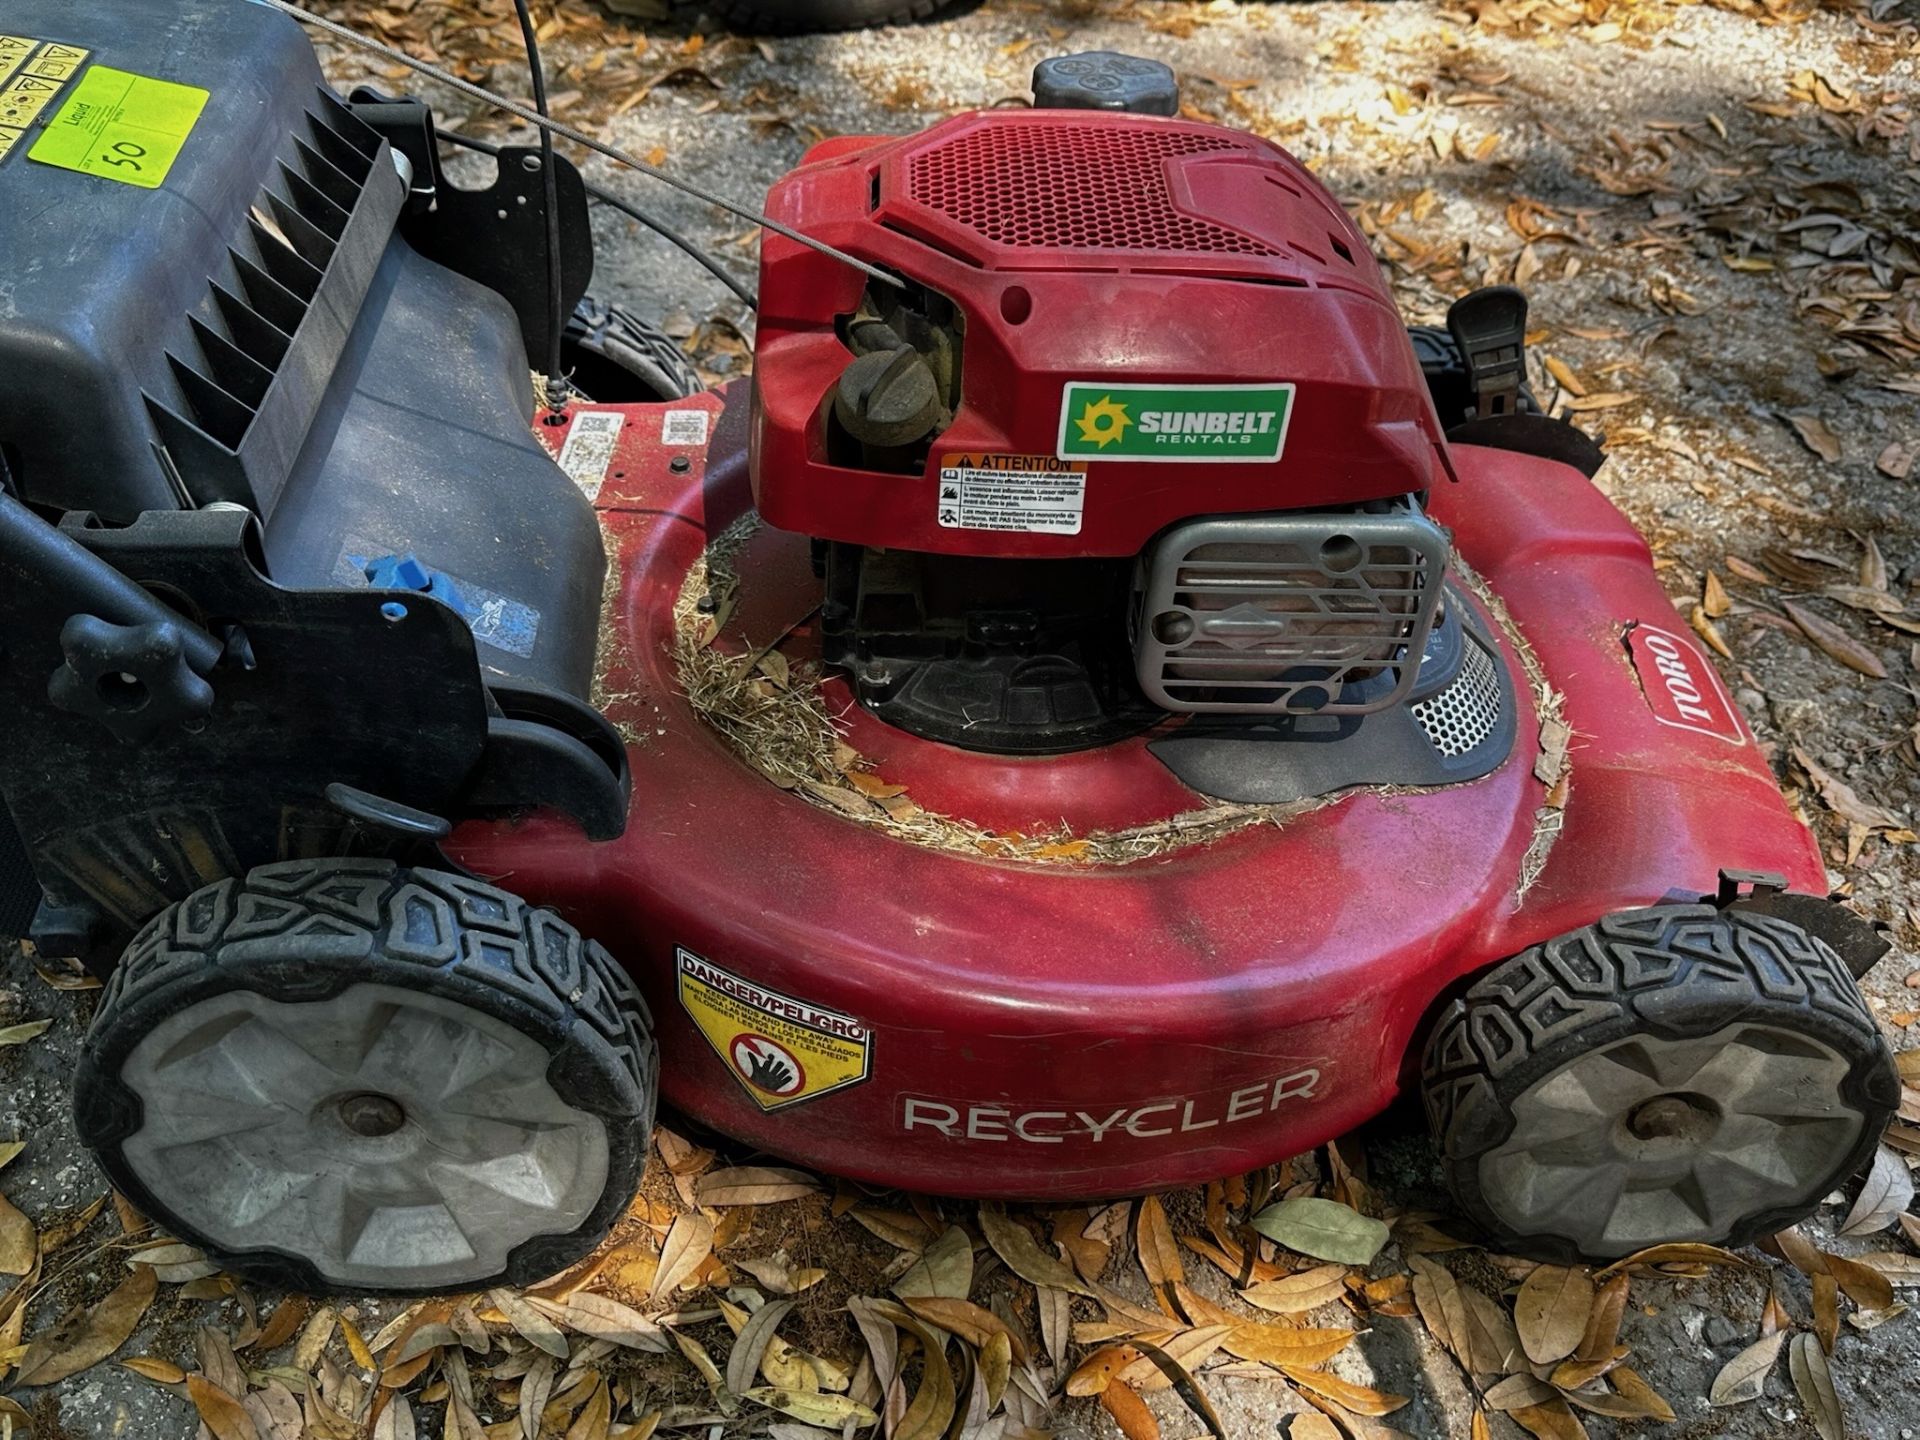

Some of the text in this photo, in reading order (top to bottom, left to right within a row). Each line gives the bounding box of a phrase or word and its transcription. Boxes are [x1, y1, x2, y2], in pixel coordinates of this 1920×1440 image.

[63, 102, 91, 127] Liquid
[102, 141, 147, 171] 50
[1138, 411, 1276, 434] SUNBELT
[1155, 434, 1252, 444] RENTALS
[980, 454, 1071, 472] ATTENTION
[1645, 635, 1713, 722] TORO
[683, 955, 864, 1040] DANGER/PELIGRO
[684, 981, 861, 1059] MANTENGA LAS MANOS Y LOS PIES ALEJADOS
[705, 987, 836, 1045] KEEP HANDS AND FEET AWAY
[737, 1017, 754, 1029] LES
[755, 1026, 784, 1042] MAINS
[786, 1037, 797, 1047] ET
[800, 1042, 819, 1054] LES
[820, 1048, 849, 1063] PIEDS
[904, 1069, 1321, 1144] RECYCLER
